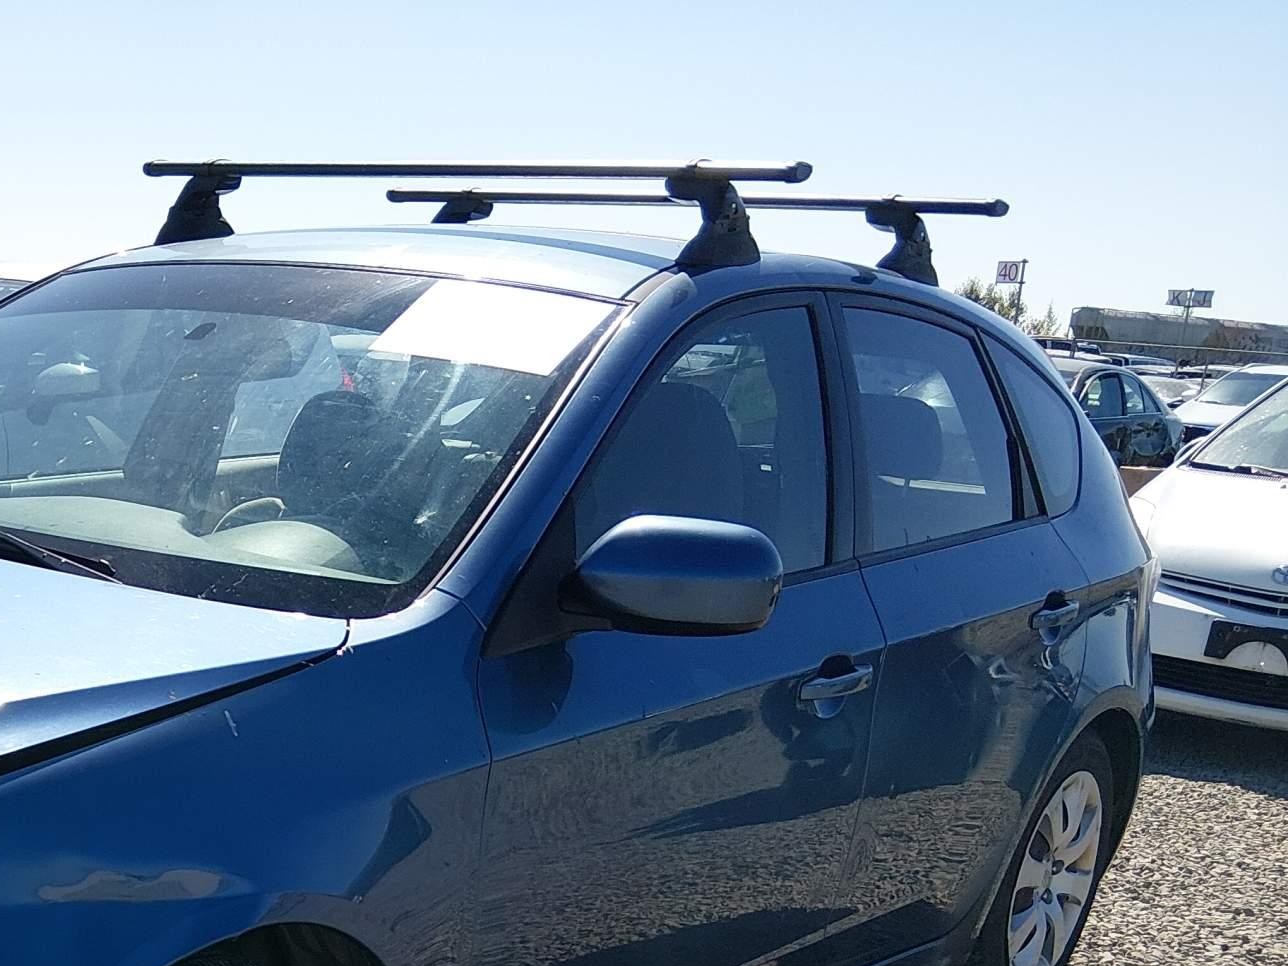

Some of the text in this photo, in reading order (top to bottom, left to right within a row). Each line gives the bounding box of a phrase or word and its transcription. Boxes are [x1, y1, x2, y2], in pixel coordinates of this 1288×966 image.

[998, 263, 1018, 281] 40
[1171, 290, 1183, 305] K
[1197, 291, 1208, 306] J
